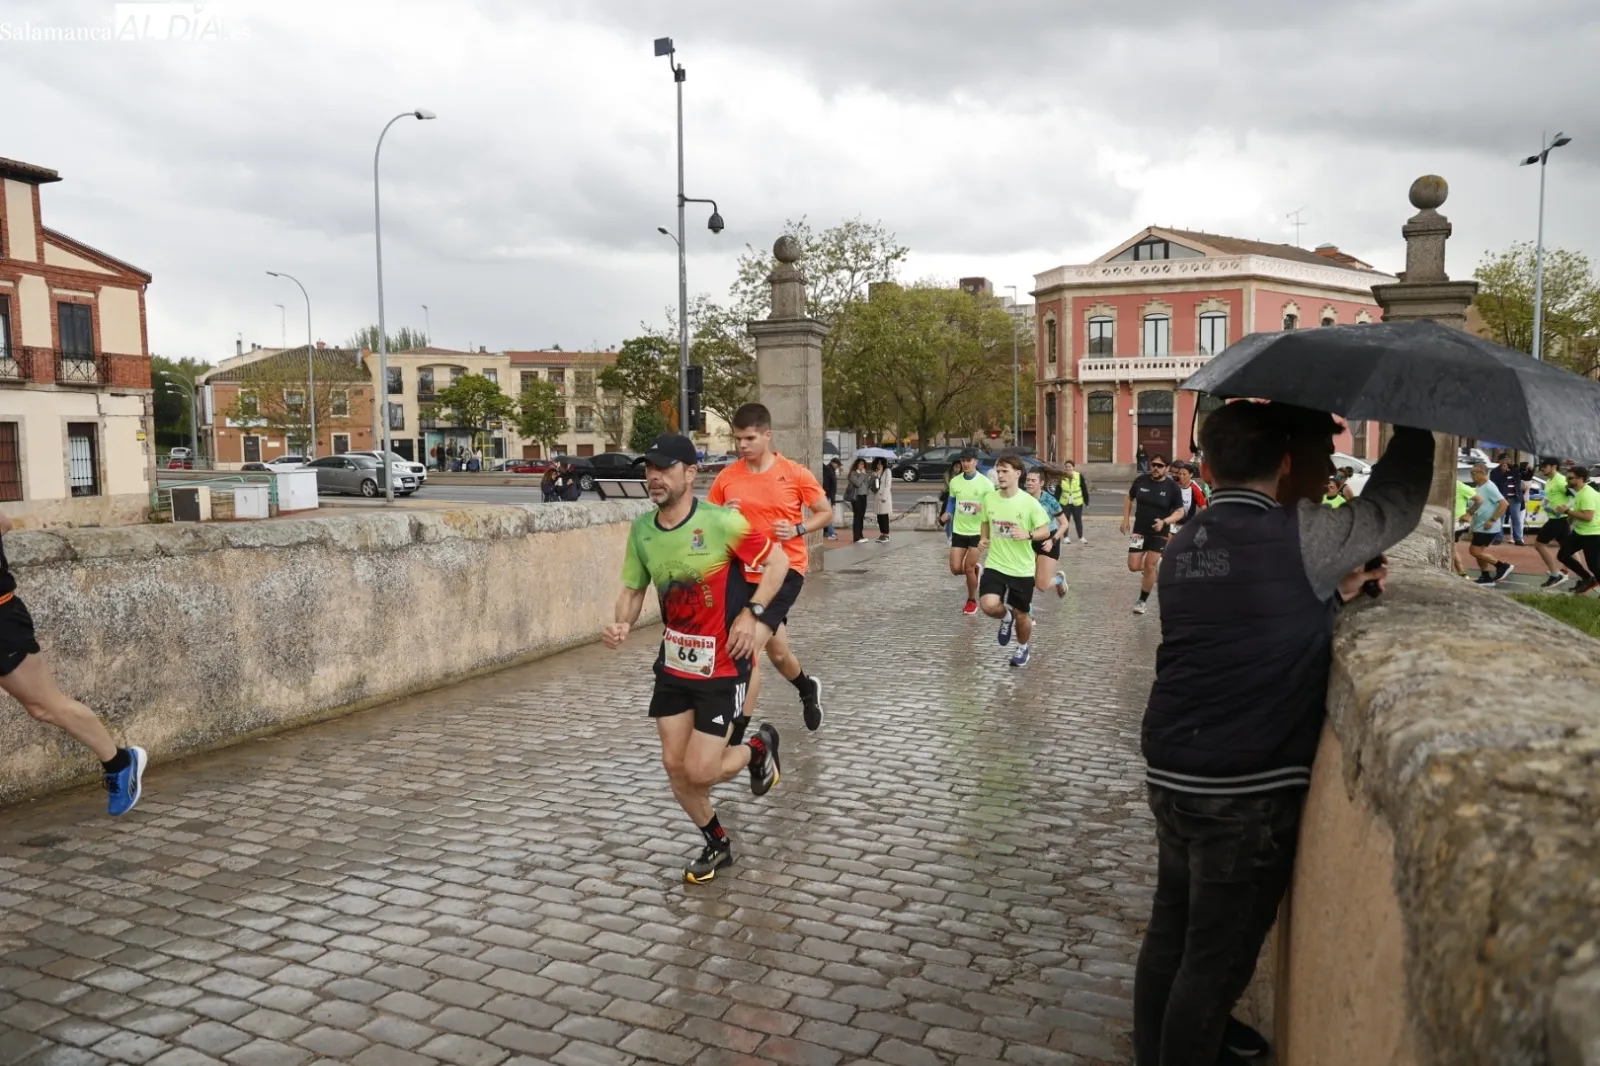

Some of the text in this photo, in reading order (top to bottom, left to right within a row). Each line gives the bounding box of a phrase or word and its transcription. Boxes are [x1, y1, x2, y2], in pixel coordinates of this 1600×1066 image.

[1175, 548, 1230, 578] PLNS
[702, 584, 713, 608] CLUB
[678, 646, 698, 663] 66
